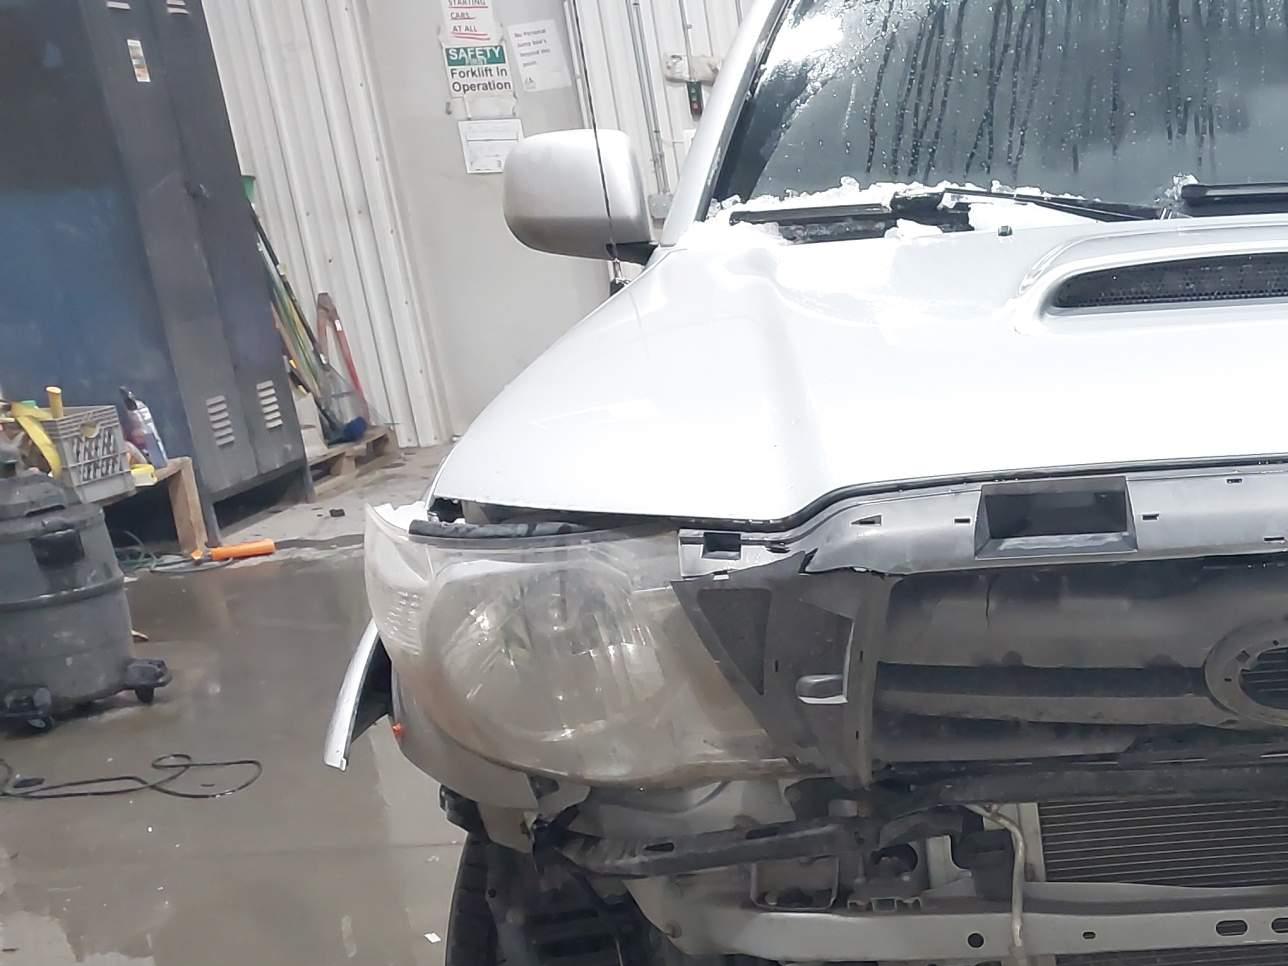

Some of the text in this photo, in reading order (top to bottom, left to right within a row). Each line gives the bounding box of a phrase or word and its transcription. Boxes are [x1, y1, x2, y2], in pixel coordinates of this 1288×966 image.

[448, 46, 501, 60] SAFETY
[450, 66, 508, 79] Forklift In
[452, 80, 511, 94] Operation
